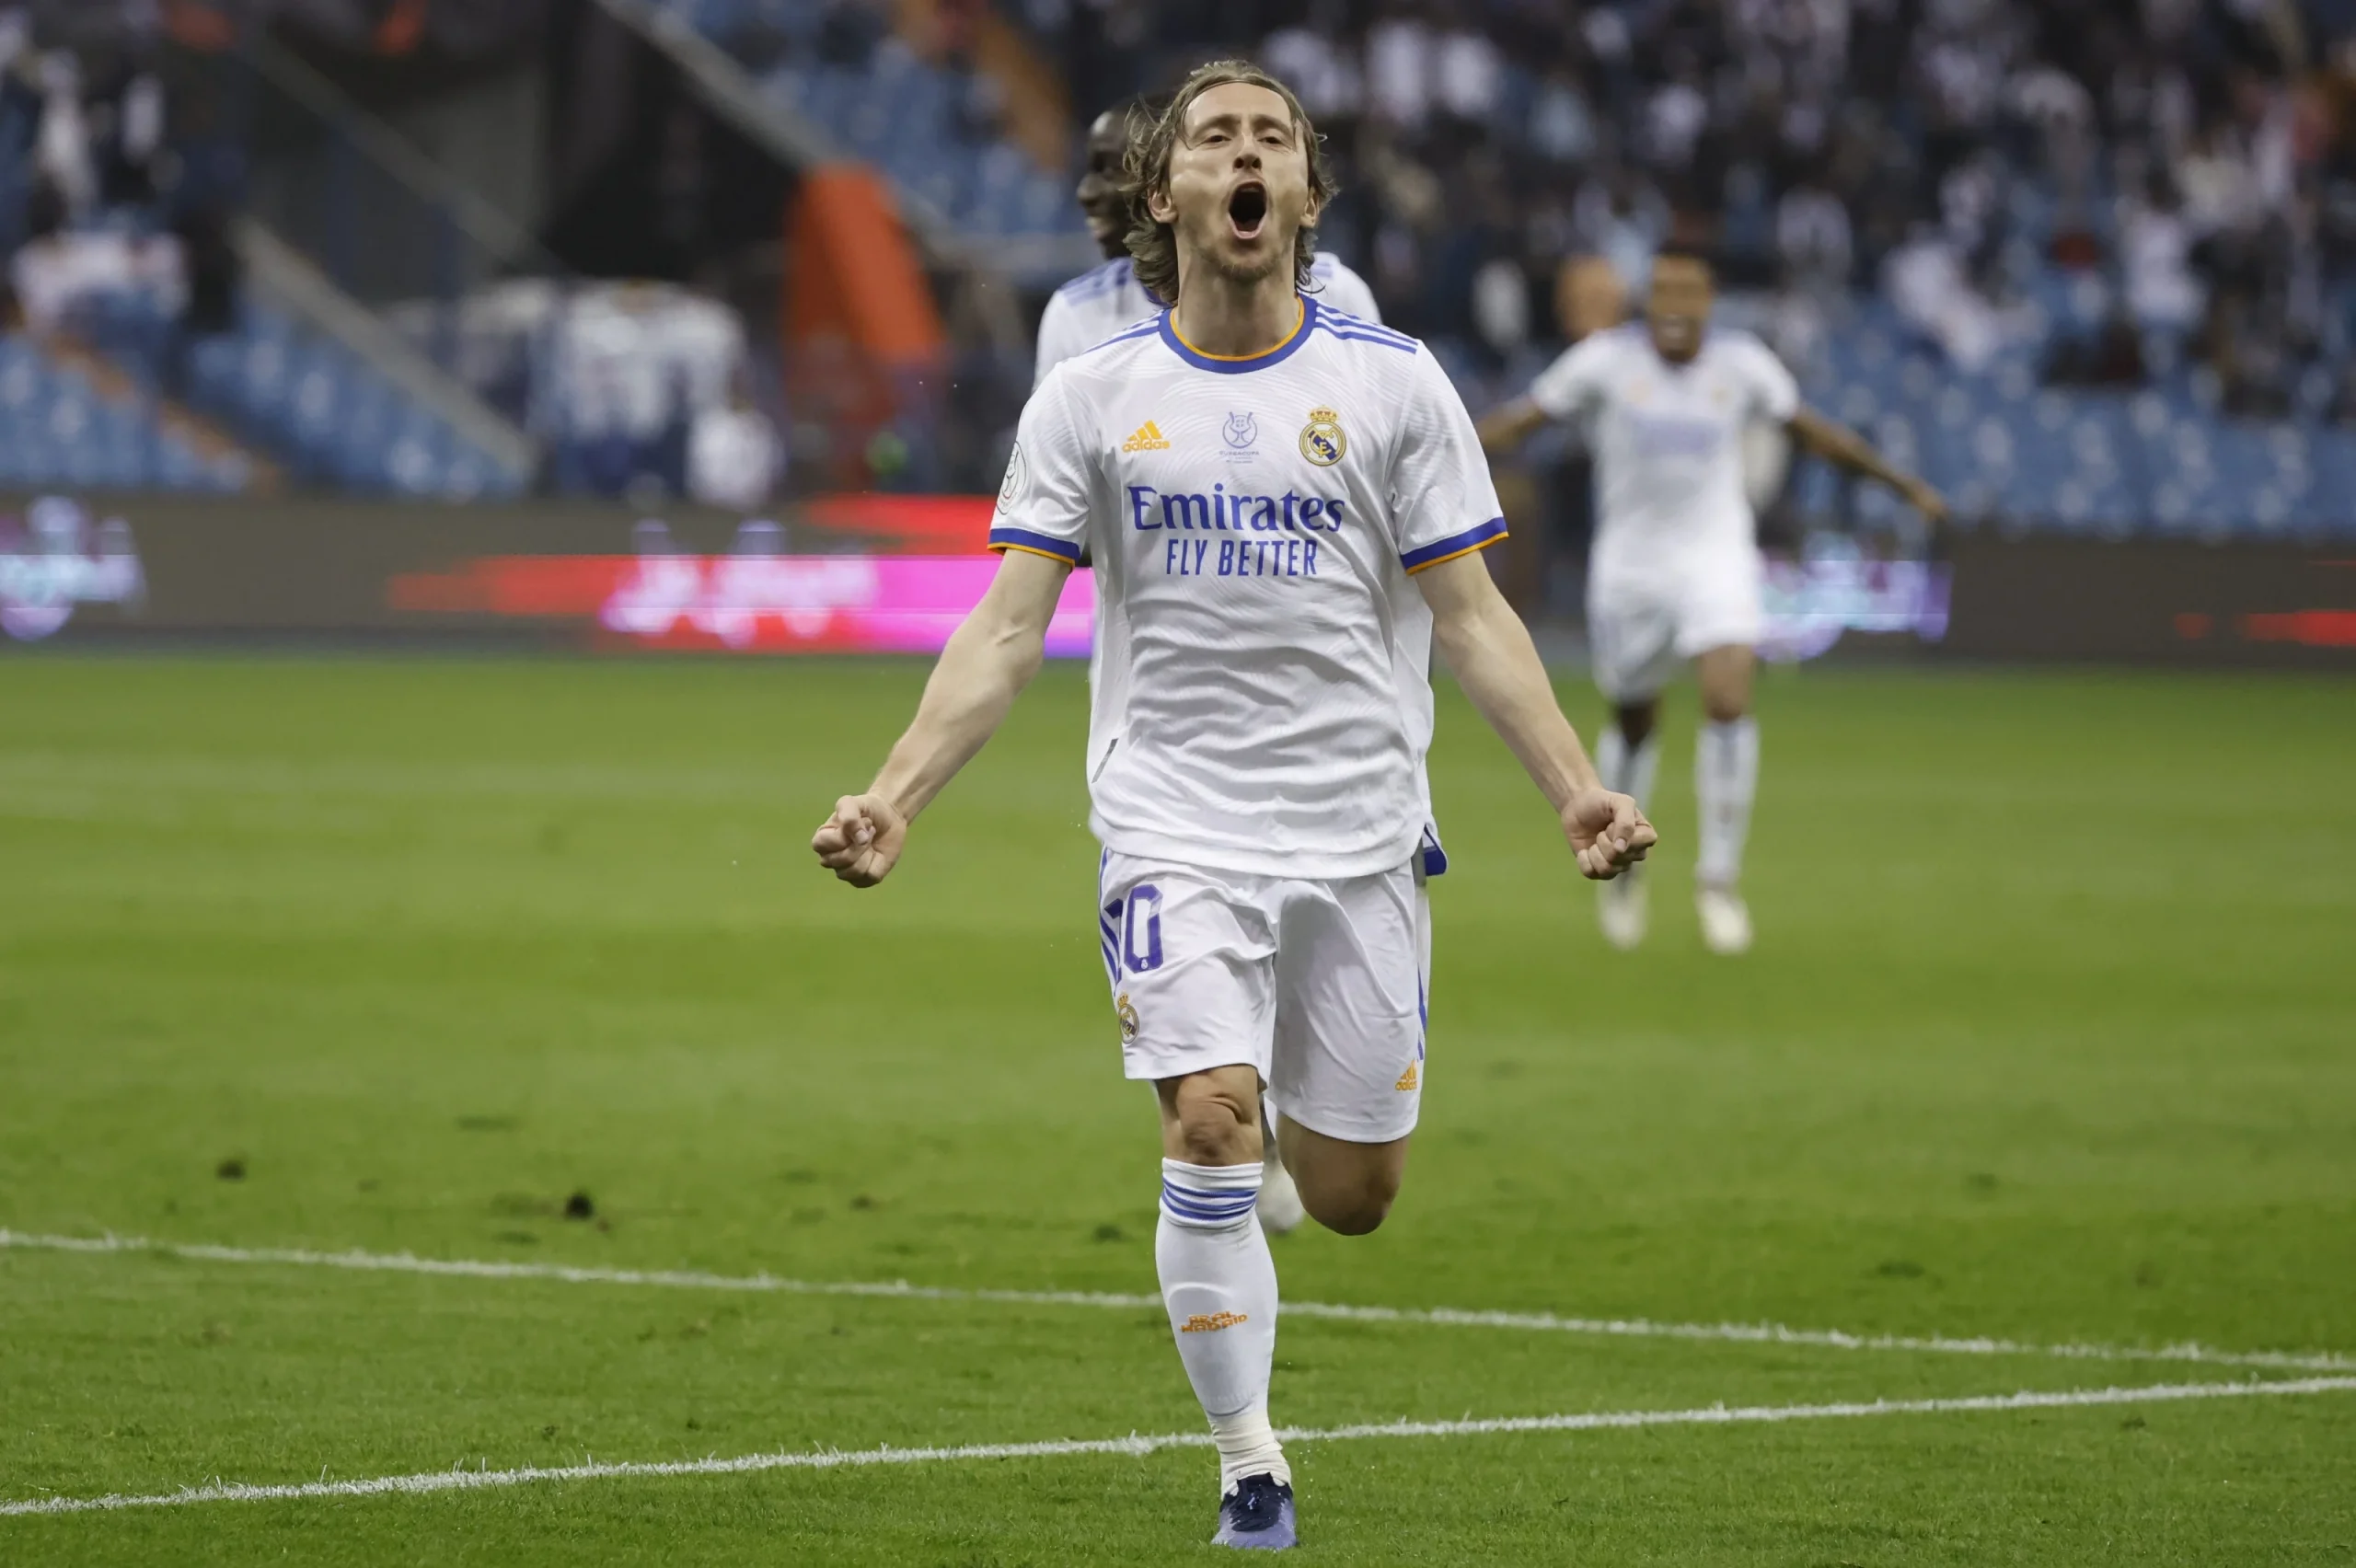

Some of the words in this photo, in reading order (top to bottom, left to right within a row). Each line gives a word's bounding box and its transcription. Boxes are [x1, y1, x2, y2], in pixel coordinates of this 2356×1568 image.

[1122, 438, 1170, 453] adidas
[1126, 483, 1345, 533] Emirates
[1166, 538, 1207, 575] FLY
[1218, 538, 1318, 576] BETTER
